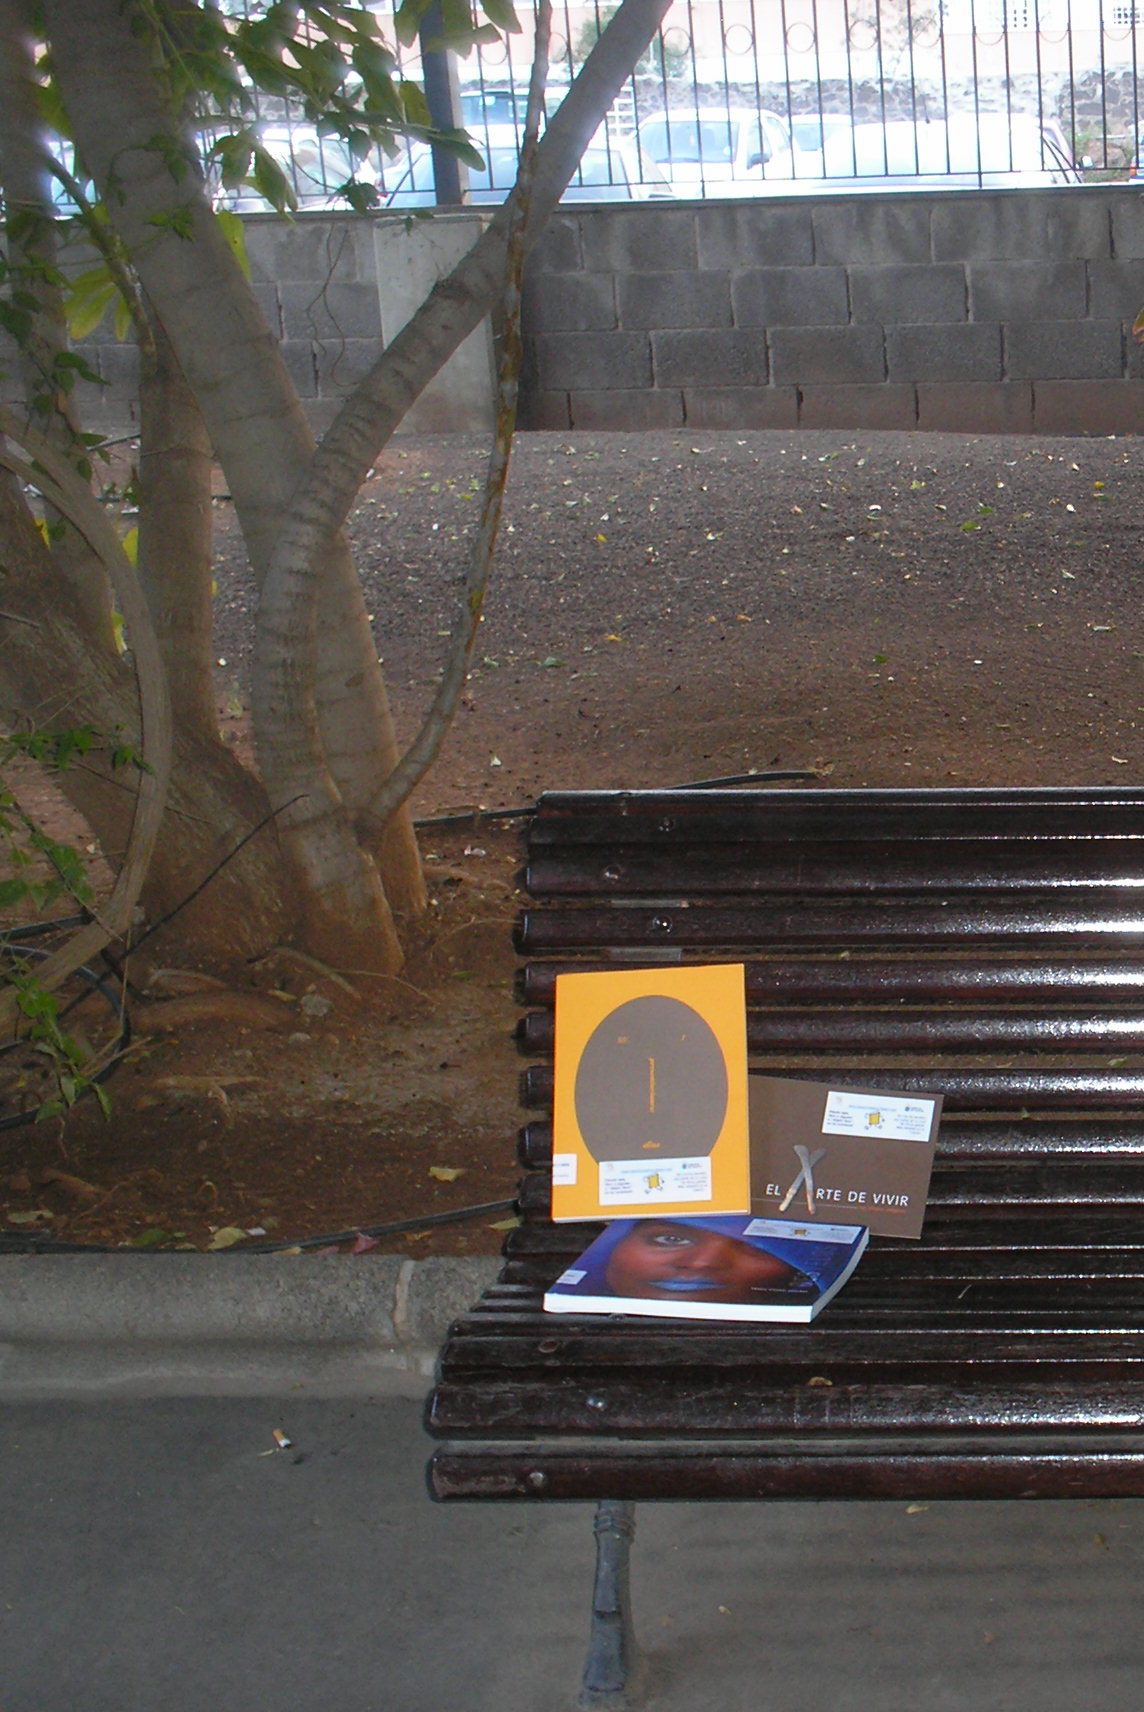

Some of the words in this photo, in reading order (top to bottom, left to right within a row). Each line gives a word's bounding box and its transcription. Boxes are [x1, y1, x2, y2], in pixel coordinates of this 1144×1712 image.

[766, 1183, 782, 1196] EL
[848, 1190, 867, 1203] DE
[873, 1193, 910, 1208] VIVIR
